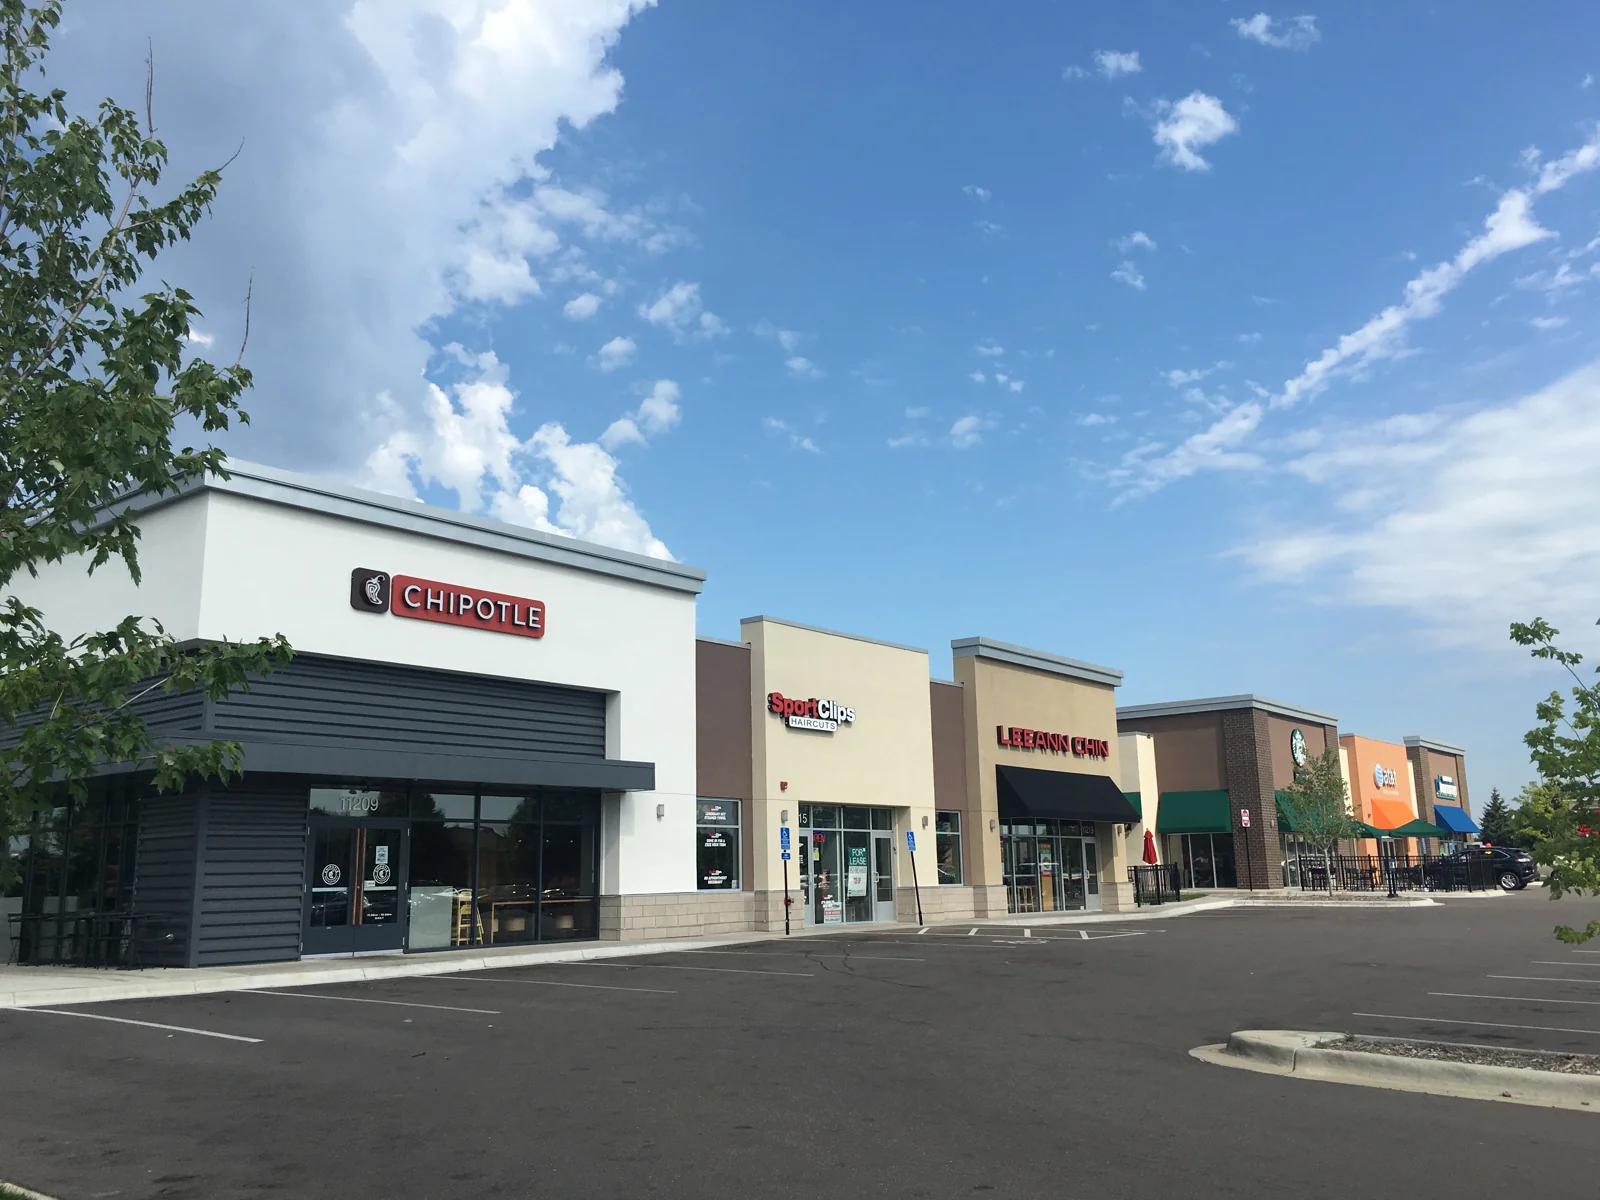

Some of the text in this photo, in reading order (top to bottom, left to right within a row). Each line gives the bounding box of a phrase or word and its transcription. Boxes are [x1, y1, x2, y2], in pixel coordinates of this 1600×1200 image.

[403, 585, 542, 629] CHIPOTLE
[790, 717, 836, 730] HAIRCUTS
[997, 725, 1109, 758] LEEANN CHIN
[340, 796, 380, 812] 11209
[851, 848, 865, 857] FOR
[849, 856, 868, 866] LEASE
